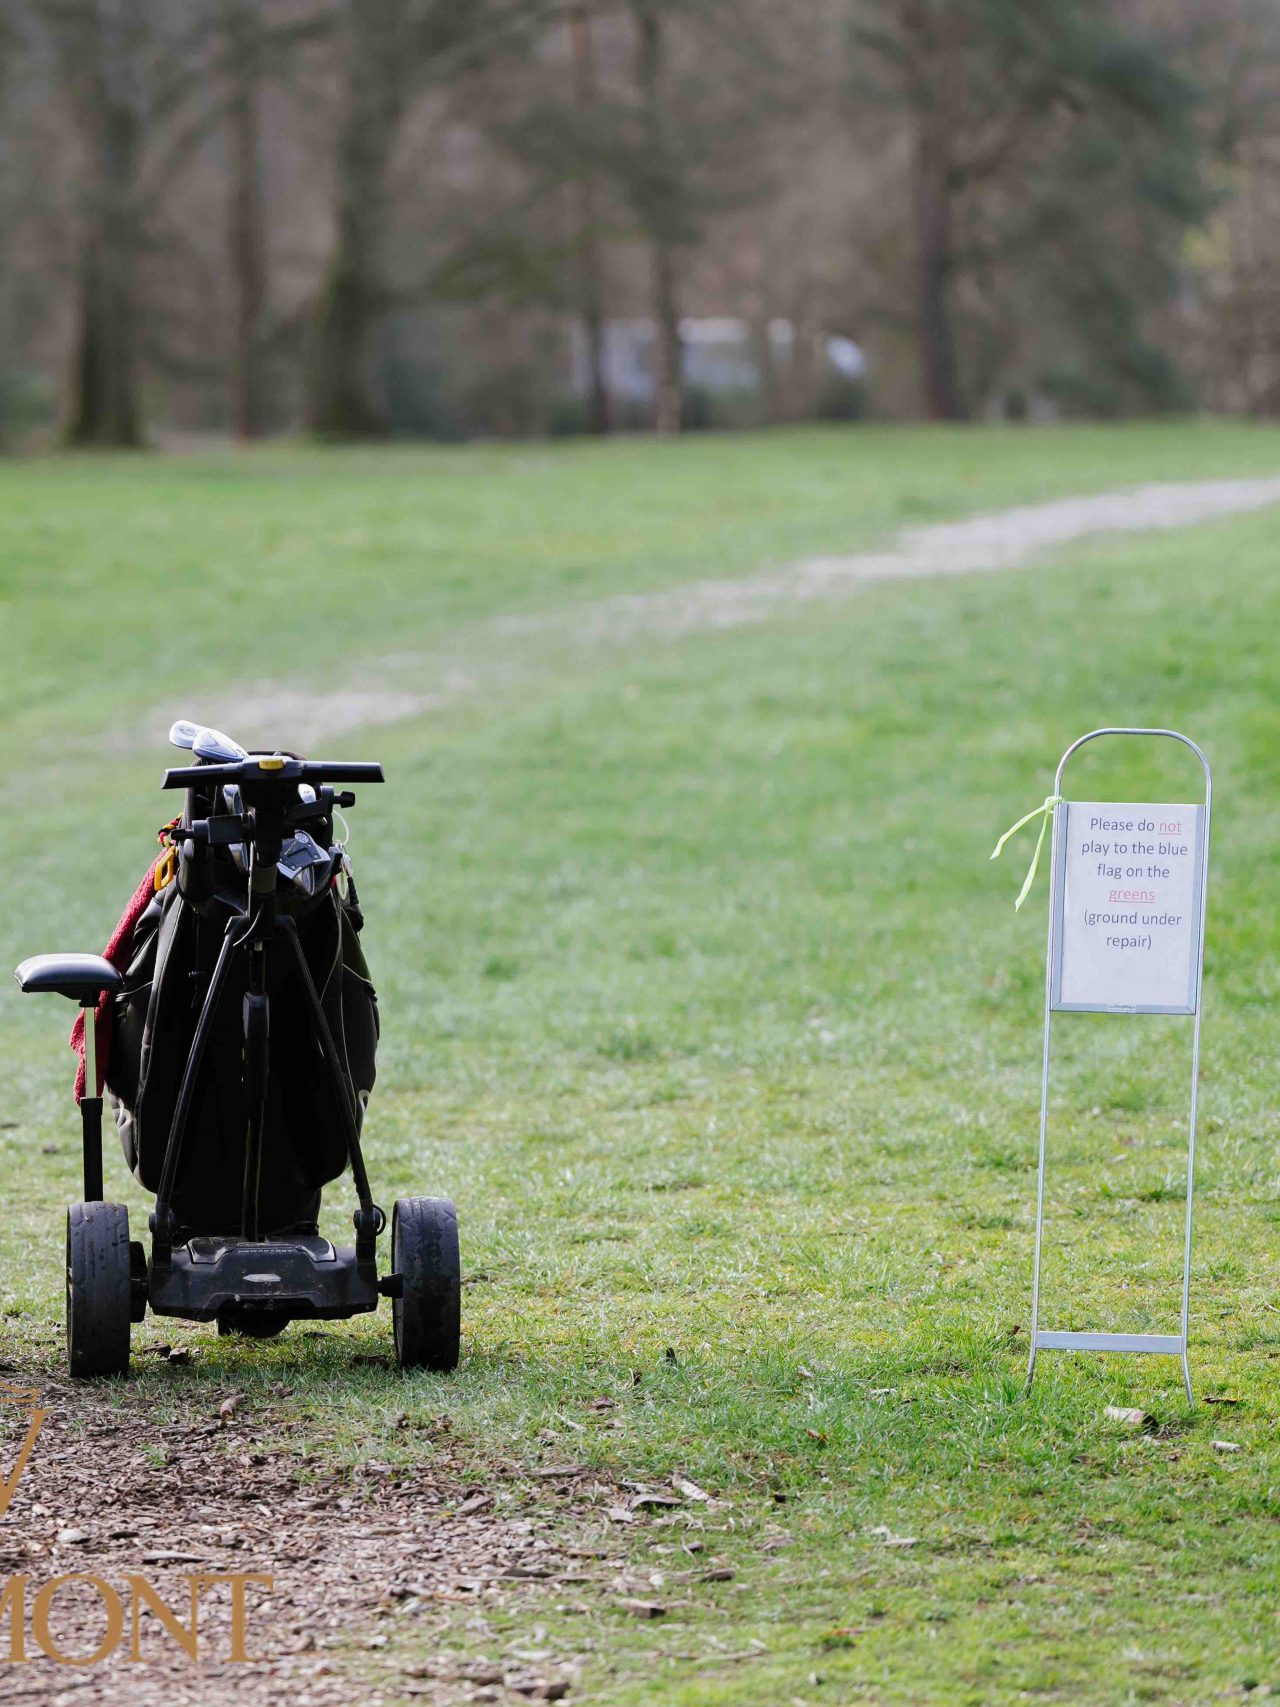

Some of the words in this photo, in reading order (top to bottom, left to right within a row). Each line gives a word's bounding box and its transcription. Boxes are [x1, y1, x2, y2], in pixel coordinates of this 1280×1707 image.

[1090, 817, 1134, 831] Please
[1137, 819, 1155, 832] do
[1159, 821, 1183, 835] not
[1081, 840, 1110, 856] play
[1114, 843, 1128, 854] to
[1132, 842, 1155, 854] the
[1158, 842, 1188, 856] blue
[1097, 863, 1122, 879] flag
[1126, 867, 1143, 877] on
[1147, 865, 1170, 878] the
[1108, 890, 1156, 903] greens
[1084, 910, 1138, 926] (ground
[1142, 912, 1183, 926] under
[1106, 935, 1152, 950] repair)
